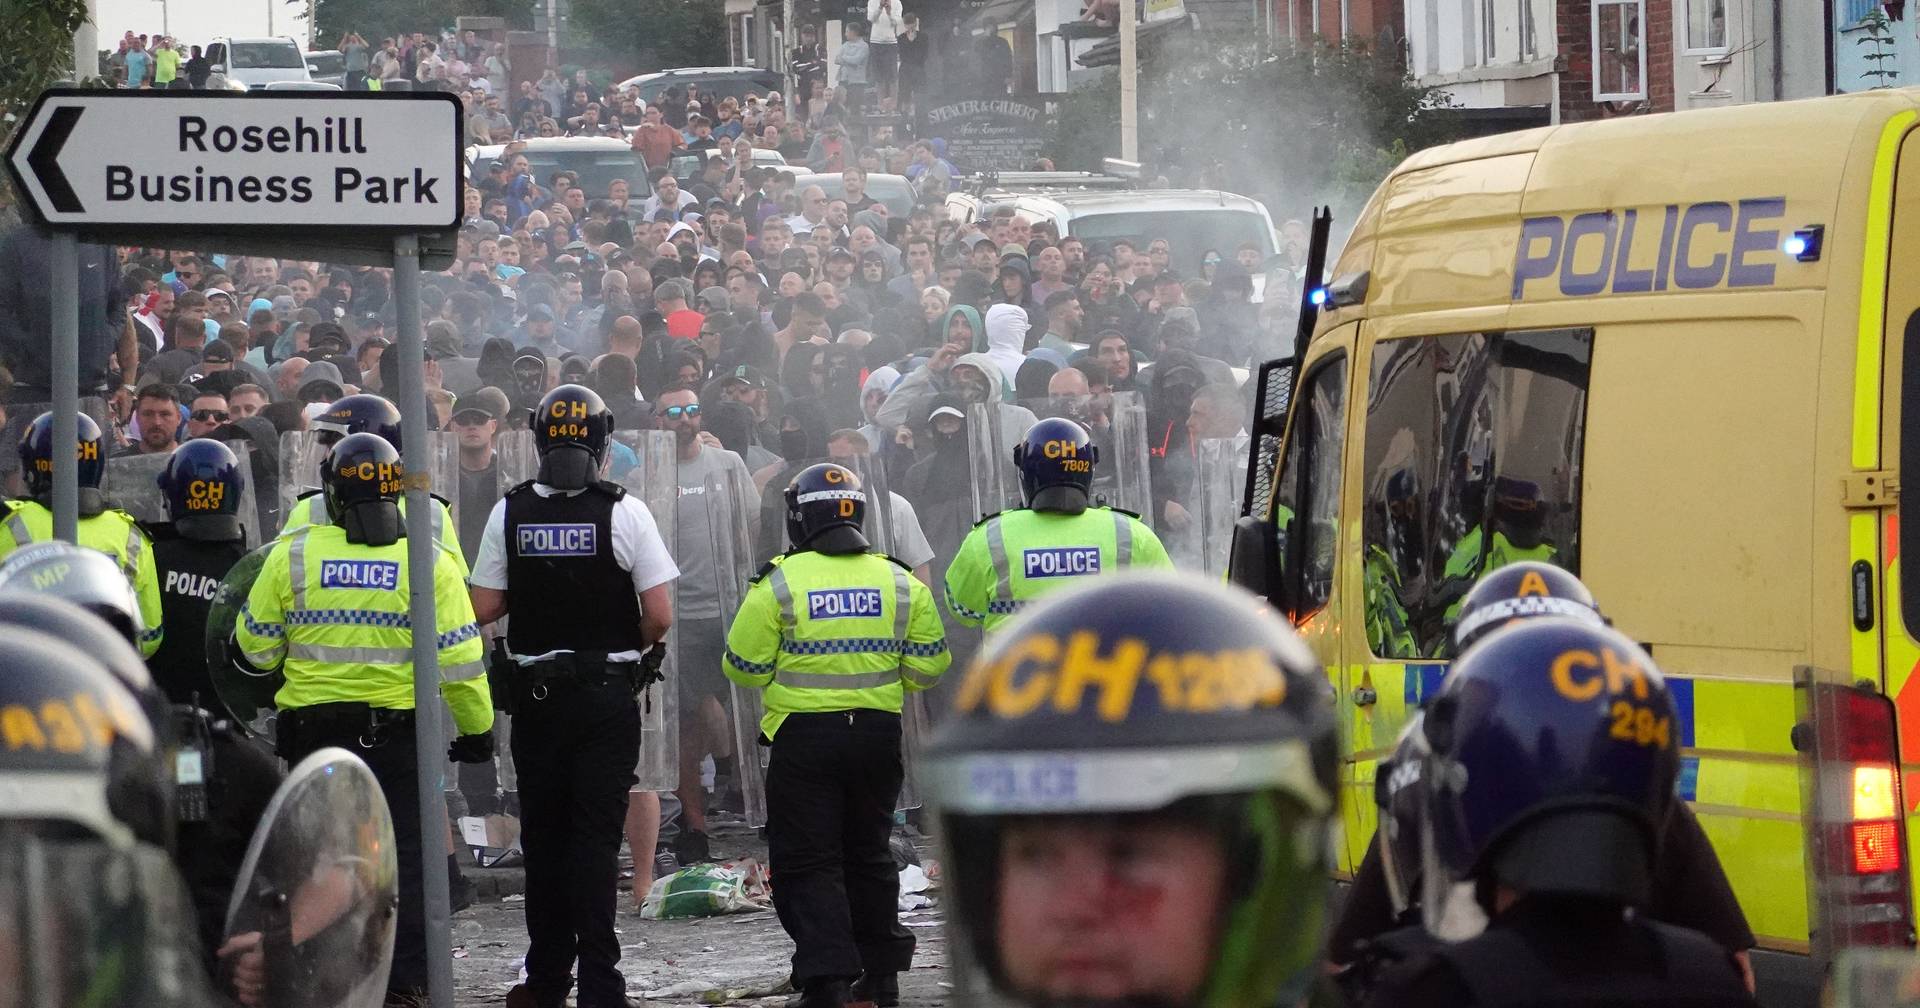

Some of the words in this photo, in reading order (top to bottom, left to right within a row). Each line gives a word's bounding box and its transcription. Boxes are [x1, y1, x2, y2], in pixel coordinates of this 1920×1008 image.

[179, 115, 368, 154] Rosehill
[105, 165, 313, 203] Business
[335, 167, 440, 204] Park
[1511, 196, 1786, 301] POLICE
[551, 400, 588, 419] CH
[549, 424, 589, 438] 6404
[1043, 440, 1078, 459] CH
[358, 462, 392, 481] CH
[1062, 460, 1090, 473] 7802
[190, 480, 224, 499] CH
[186, 498, 220, 510] 1043
[839, 499, 855, 517] D
[520, 529, 592, 551] POLICE
[323, 562, 396, 587] POLICE
[1026, 551, 1098, 576] POLICE
[165, 570, 230, 605] POLICE
[1517, 570, 1551, 598] A
[810, 592, 881, 616] POLICE
[989, 630, 1146, 724] CH
[1551, 647, 1649, 702] CH
